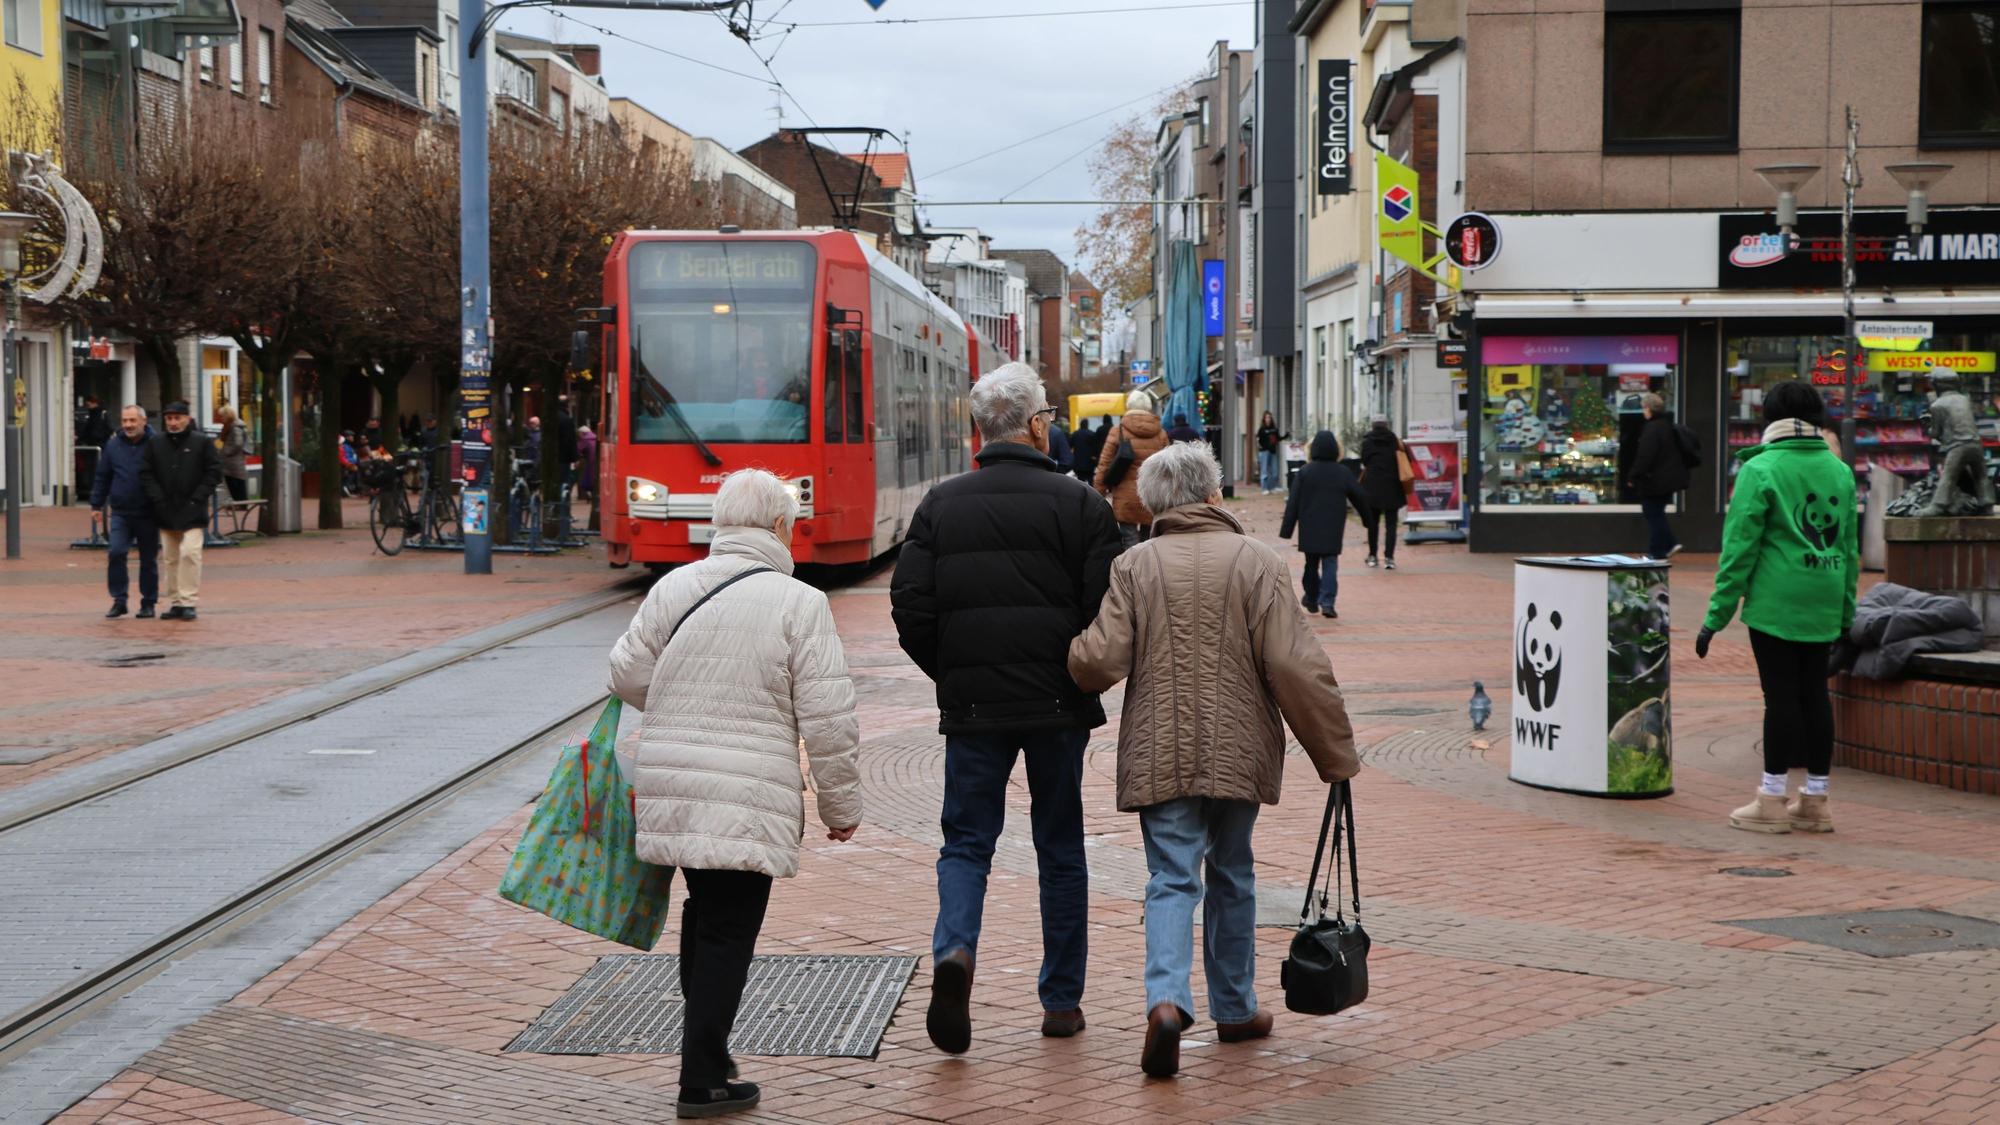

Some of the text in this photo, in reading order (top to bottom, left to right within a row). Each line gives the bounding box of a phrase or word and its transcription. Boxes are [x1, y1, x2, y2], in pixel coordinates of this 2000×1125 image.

[1321, 76, 1347, 178] fielmann
[1941, 233, 2000, 261] MAR
[653, 251, 799, 279] 7 Benzelrath
[1860, 324, 1928, 335] Antoniterstraße
[1886, 356, 1979, 368] WEST LOTTO
[1803, 553, 1841, 570] WWF
[1515, 716, 1562, 751] WWF
